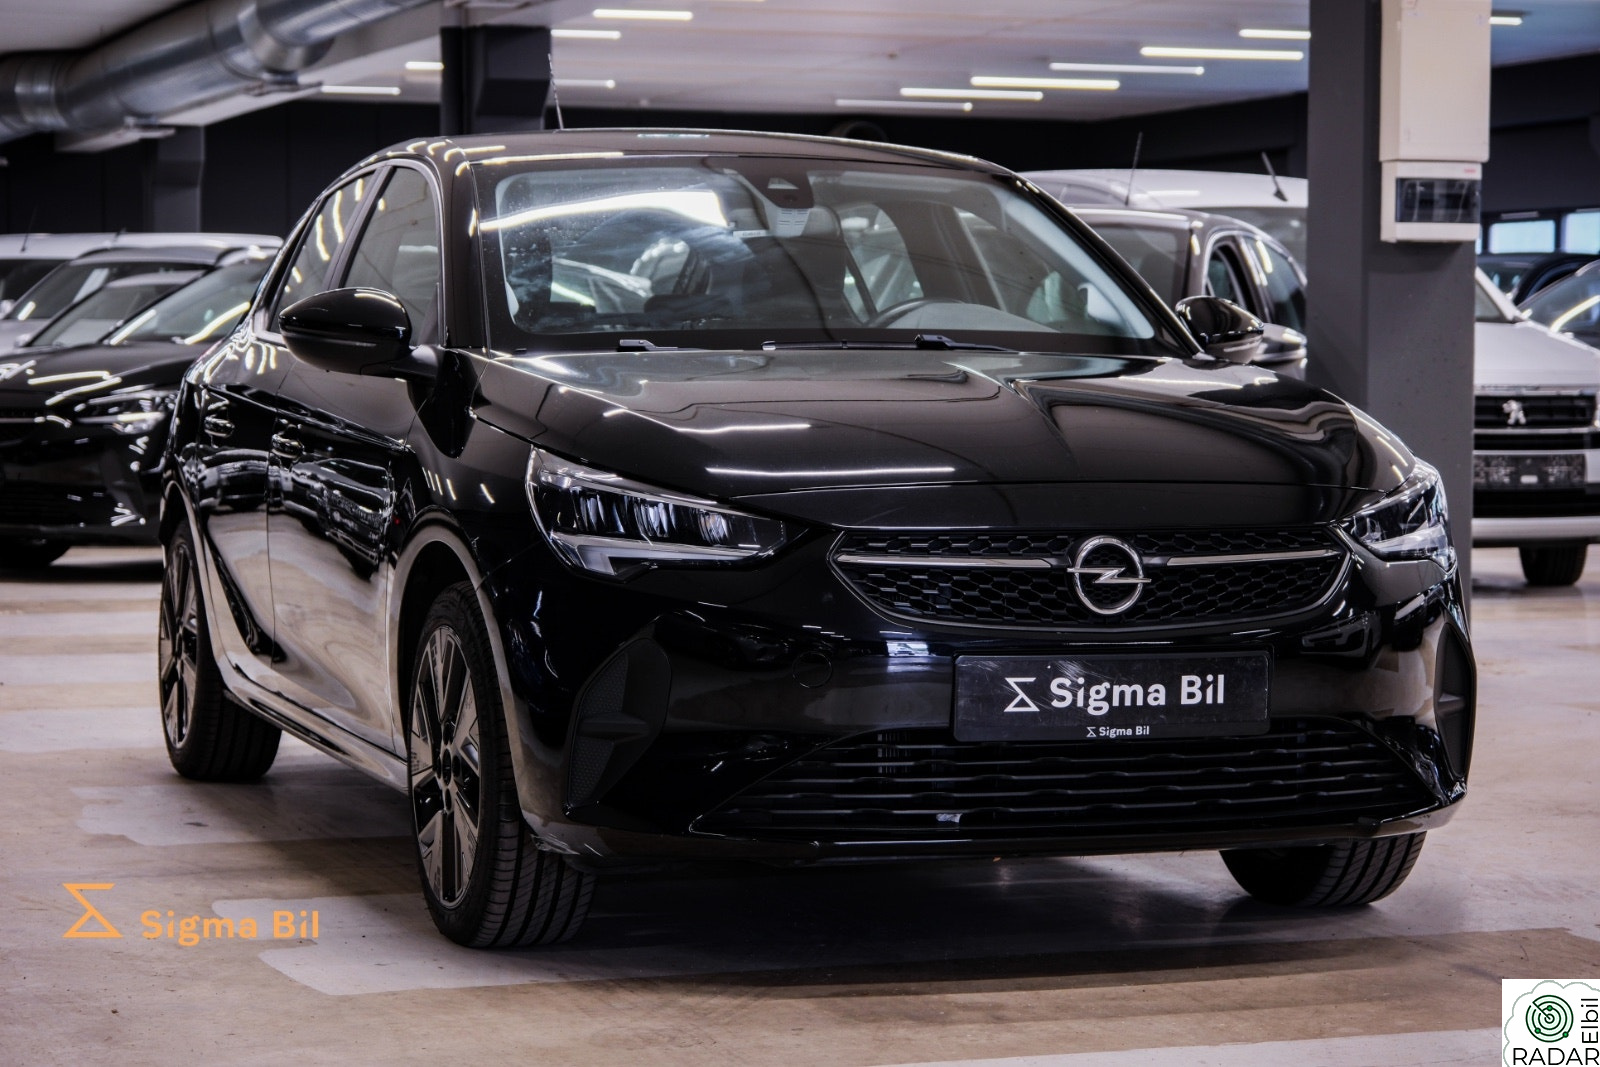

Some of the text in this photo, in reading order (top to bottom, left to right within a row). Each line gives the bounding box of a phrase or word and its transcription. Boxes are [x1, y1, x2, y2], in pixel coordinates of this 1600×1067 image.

[1050, 674, 1225, 716] Sigma Bil
[1099, 725, 1150, 739] Sigma Bil
